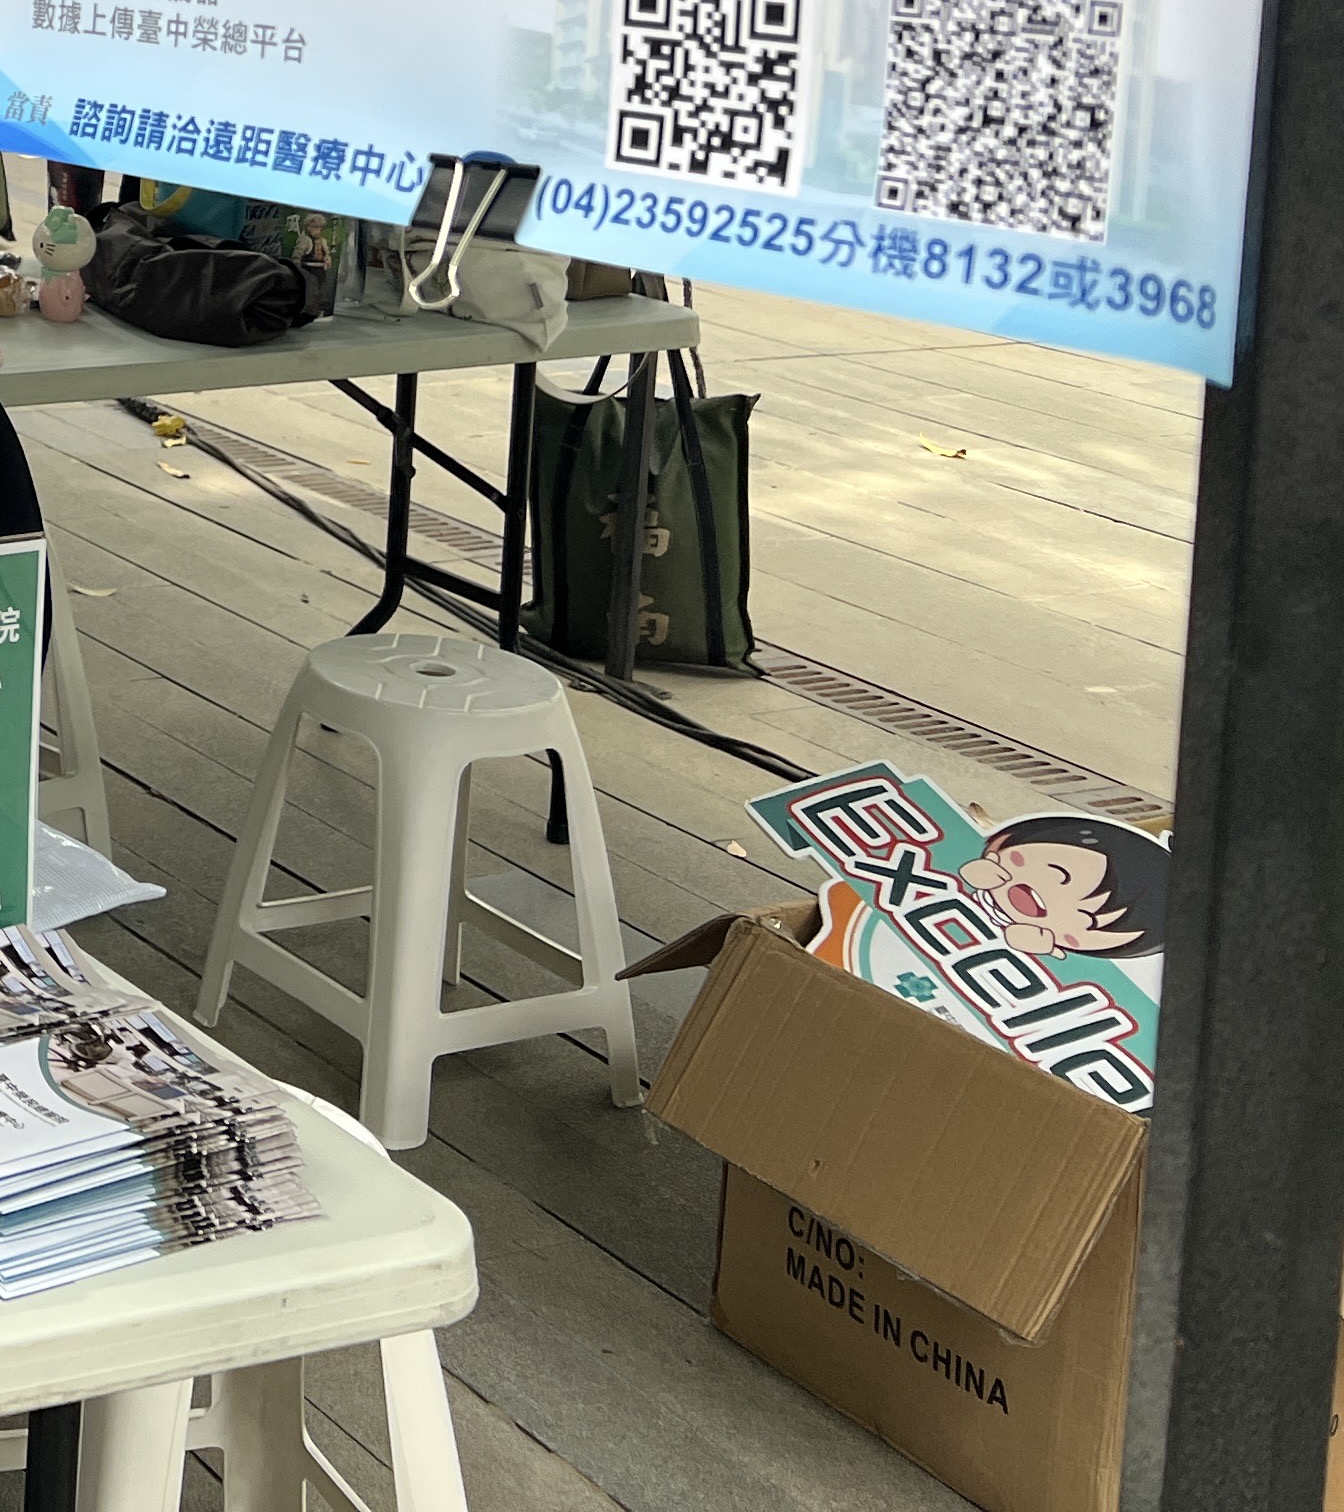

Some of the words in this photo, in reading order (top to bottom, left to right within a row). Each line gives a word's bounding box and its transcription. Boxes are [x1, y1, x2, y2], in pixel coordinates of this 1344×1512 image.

[69, 97, 424, 194] 諮詢請洽遠距醫療中心
[535, 174, 1216, 330] (04)23592525分機8132或3968
[798, 784, 1154, 1118] Excelle
[786, 1246, 865, 1326] MADE
[874, 1304, 901, 1347] IN
[911, 1329, 1011, 1416] CHINA
[788, 1205, 865, 1280] C/NO:
